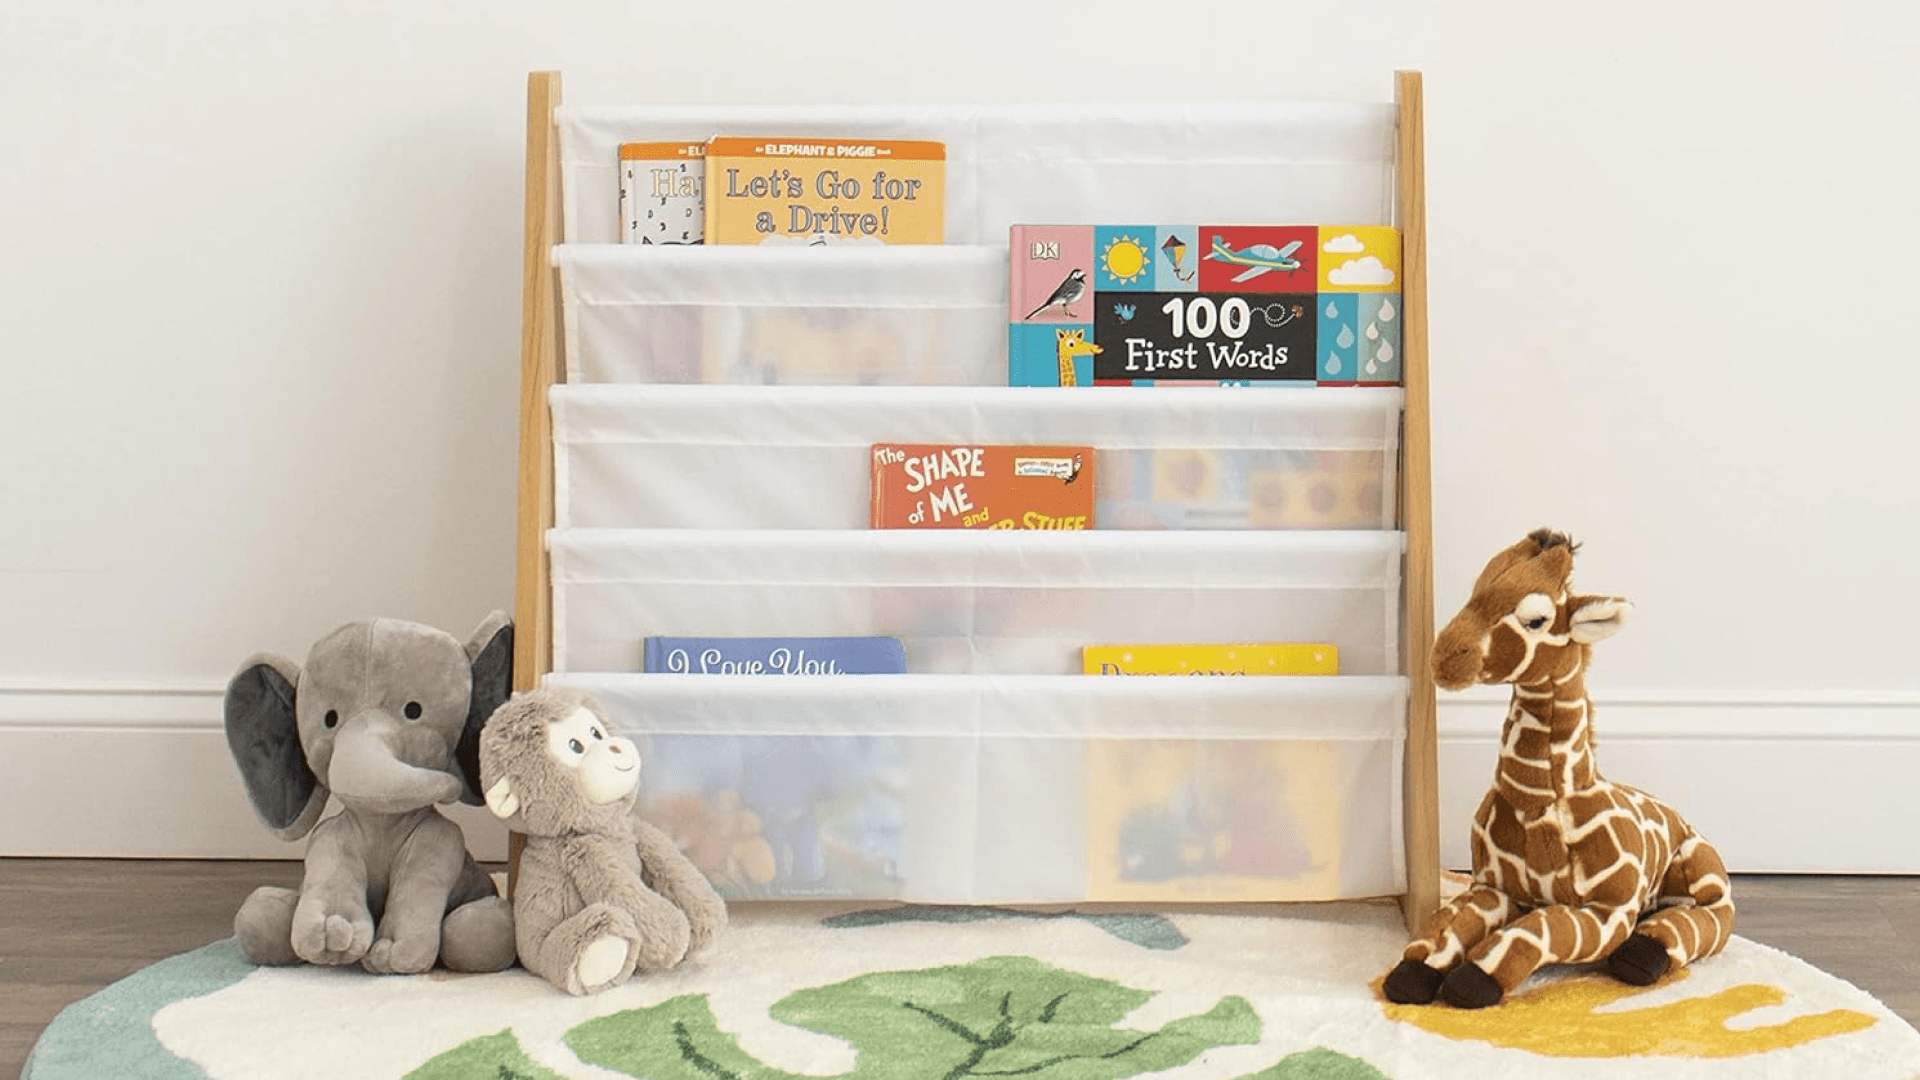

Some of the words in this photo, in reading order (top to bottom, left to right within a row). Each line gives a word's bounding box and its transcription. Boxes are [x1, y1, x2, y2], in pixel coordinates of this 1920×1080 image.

[765, 144, 826, 156] ELEPHANT
[827, 145, 835, 156] &
[837, 145, 877, 157] PIGGIE
[726, 168, 803, 199] Let's
[815, 170, 860, 200] Go
[872, 171, 922, 200] for
[755, 211, 777, 233] a
[788, 204, 890, 235] Drive!
[1032, 241, 1060, 259] DK
[1162, 297, 1251, 339] 100
[1124, 338, 1198, 372] First
[1206, 338, 1289, 372] Words
[875, 447, 905, 466] The
[904, 448, 985, 494] SHAPE
[908, 501, 925, 524] of
[929, 483, 974, 522] ME
[962, 507, 990, 527] and
[700, 648, 767, 676] Love
[768, 647, 846, 676] You
